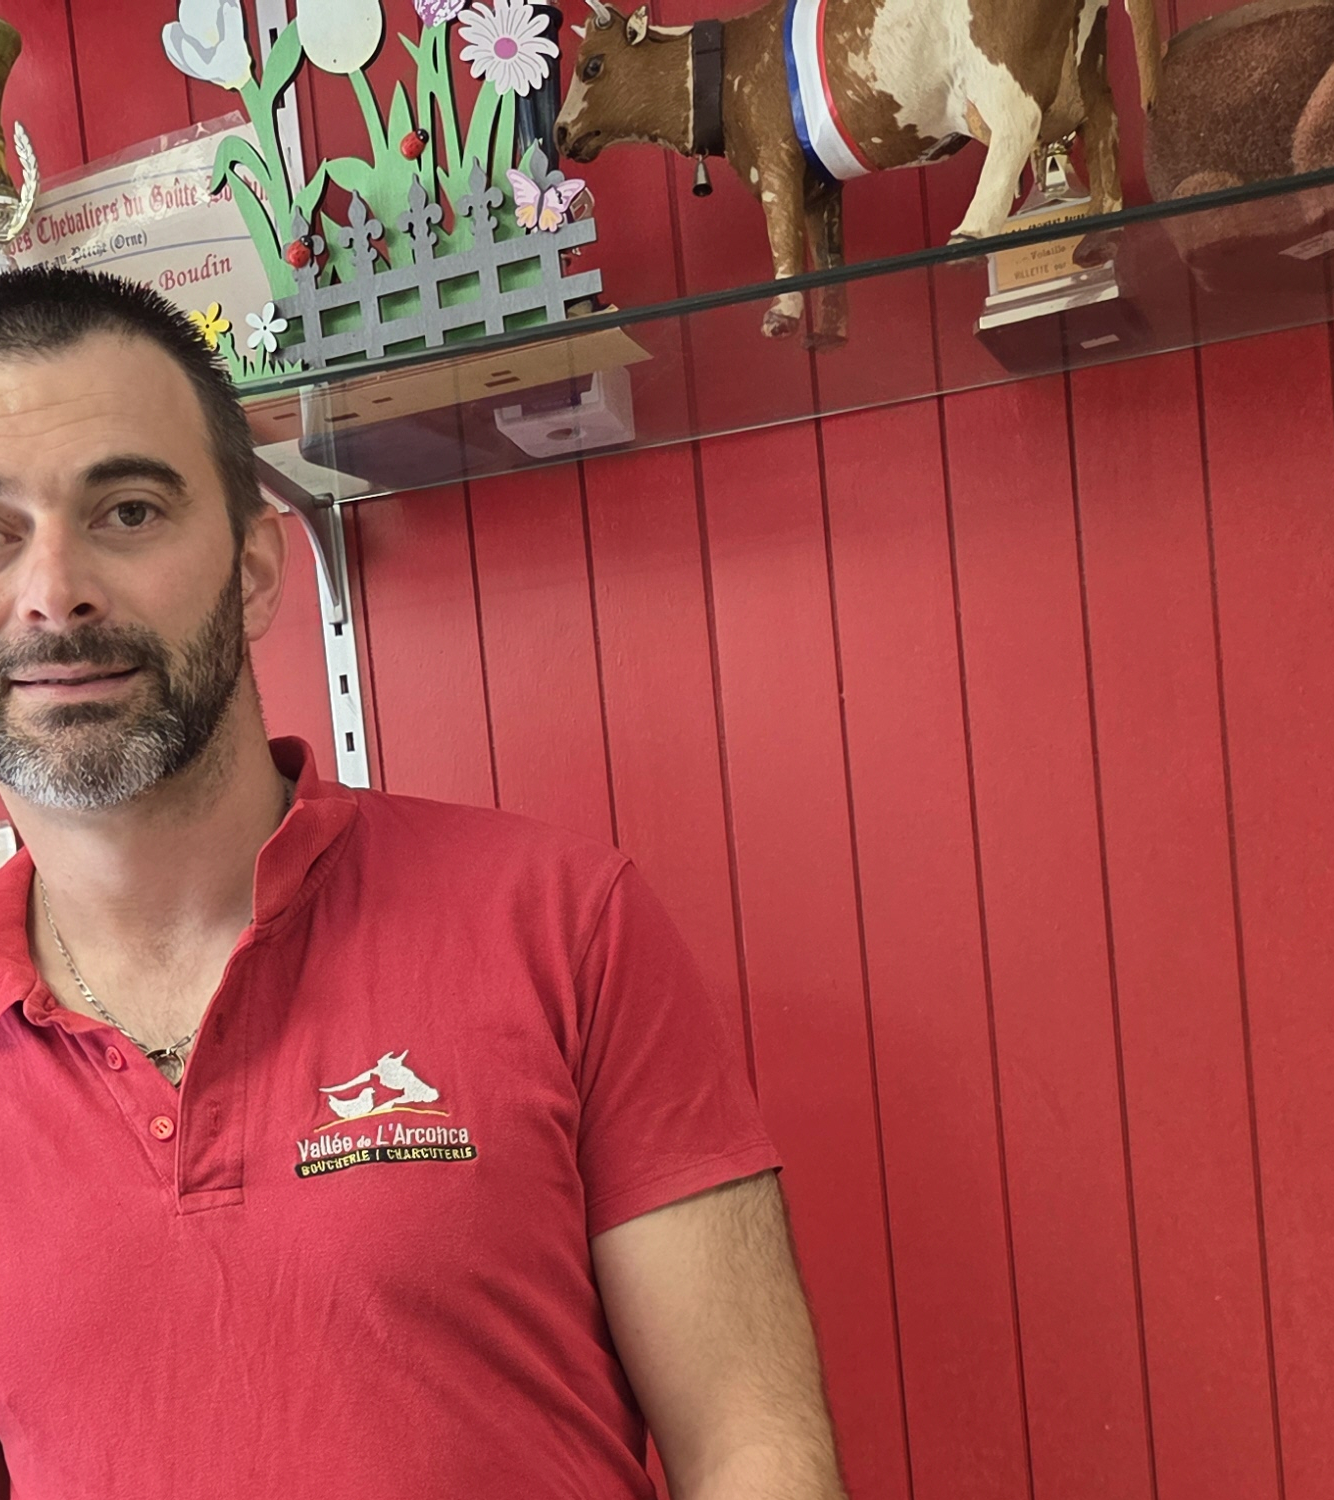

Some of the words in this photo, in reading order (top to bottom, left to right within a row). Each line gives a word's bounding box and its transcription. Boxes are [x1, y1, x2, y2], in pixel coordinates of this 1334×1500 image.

[37, 201, 117, 246] Chevaliers
[124, 189, 145, 219] du
[110, 229, 148, 254] (Orne)
[159, 253, 233, 291] Boudin
[296, 1132, 353, 1163] Vallée
[356, 1135, 372, 1147] de
[376, 1123, 469, 1146] L'Arconce
[301, 1150, 371, 1176] BOUCHERIE
[386, 1146, 472, 1160] CHARCUTERIE
